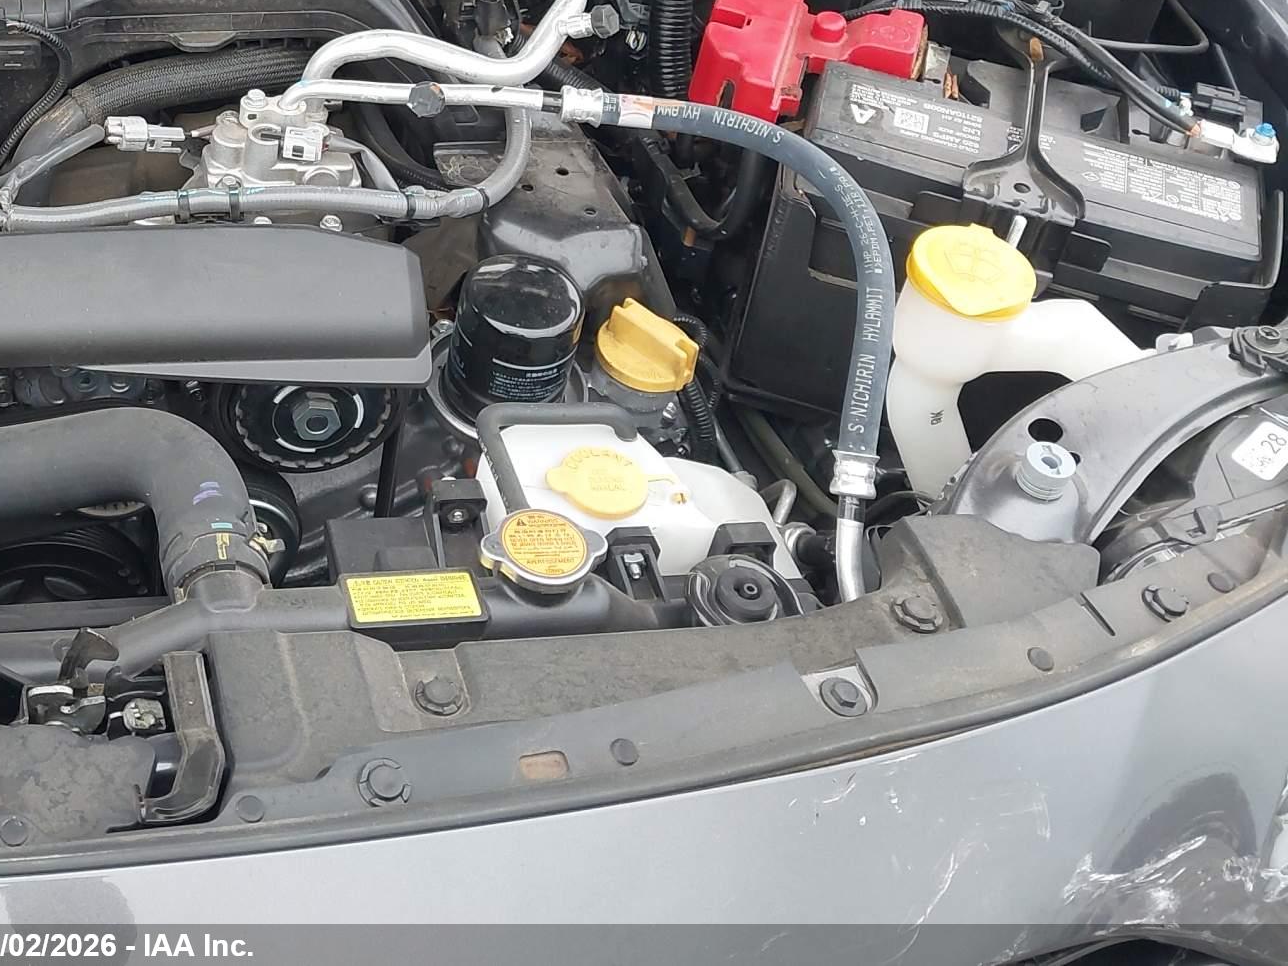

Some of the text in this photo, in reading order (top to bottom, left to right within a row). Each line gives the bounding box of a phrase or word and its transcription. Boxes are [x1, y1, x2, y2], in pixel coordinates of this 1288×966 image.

[653, 104, 701, 121] HYLAMM
[933, 131, 961, 144] AMPS
[862, 286, 884, 342] HYLAMMIT
[1260, 433, 1287, 455] 28
